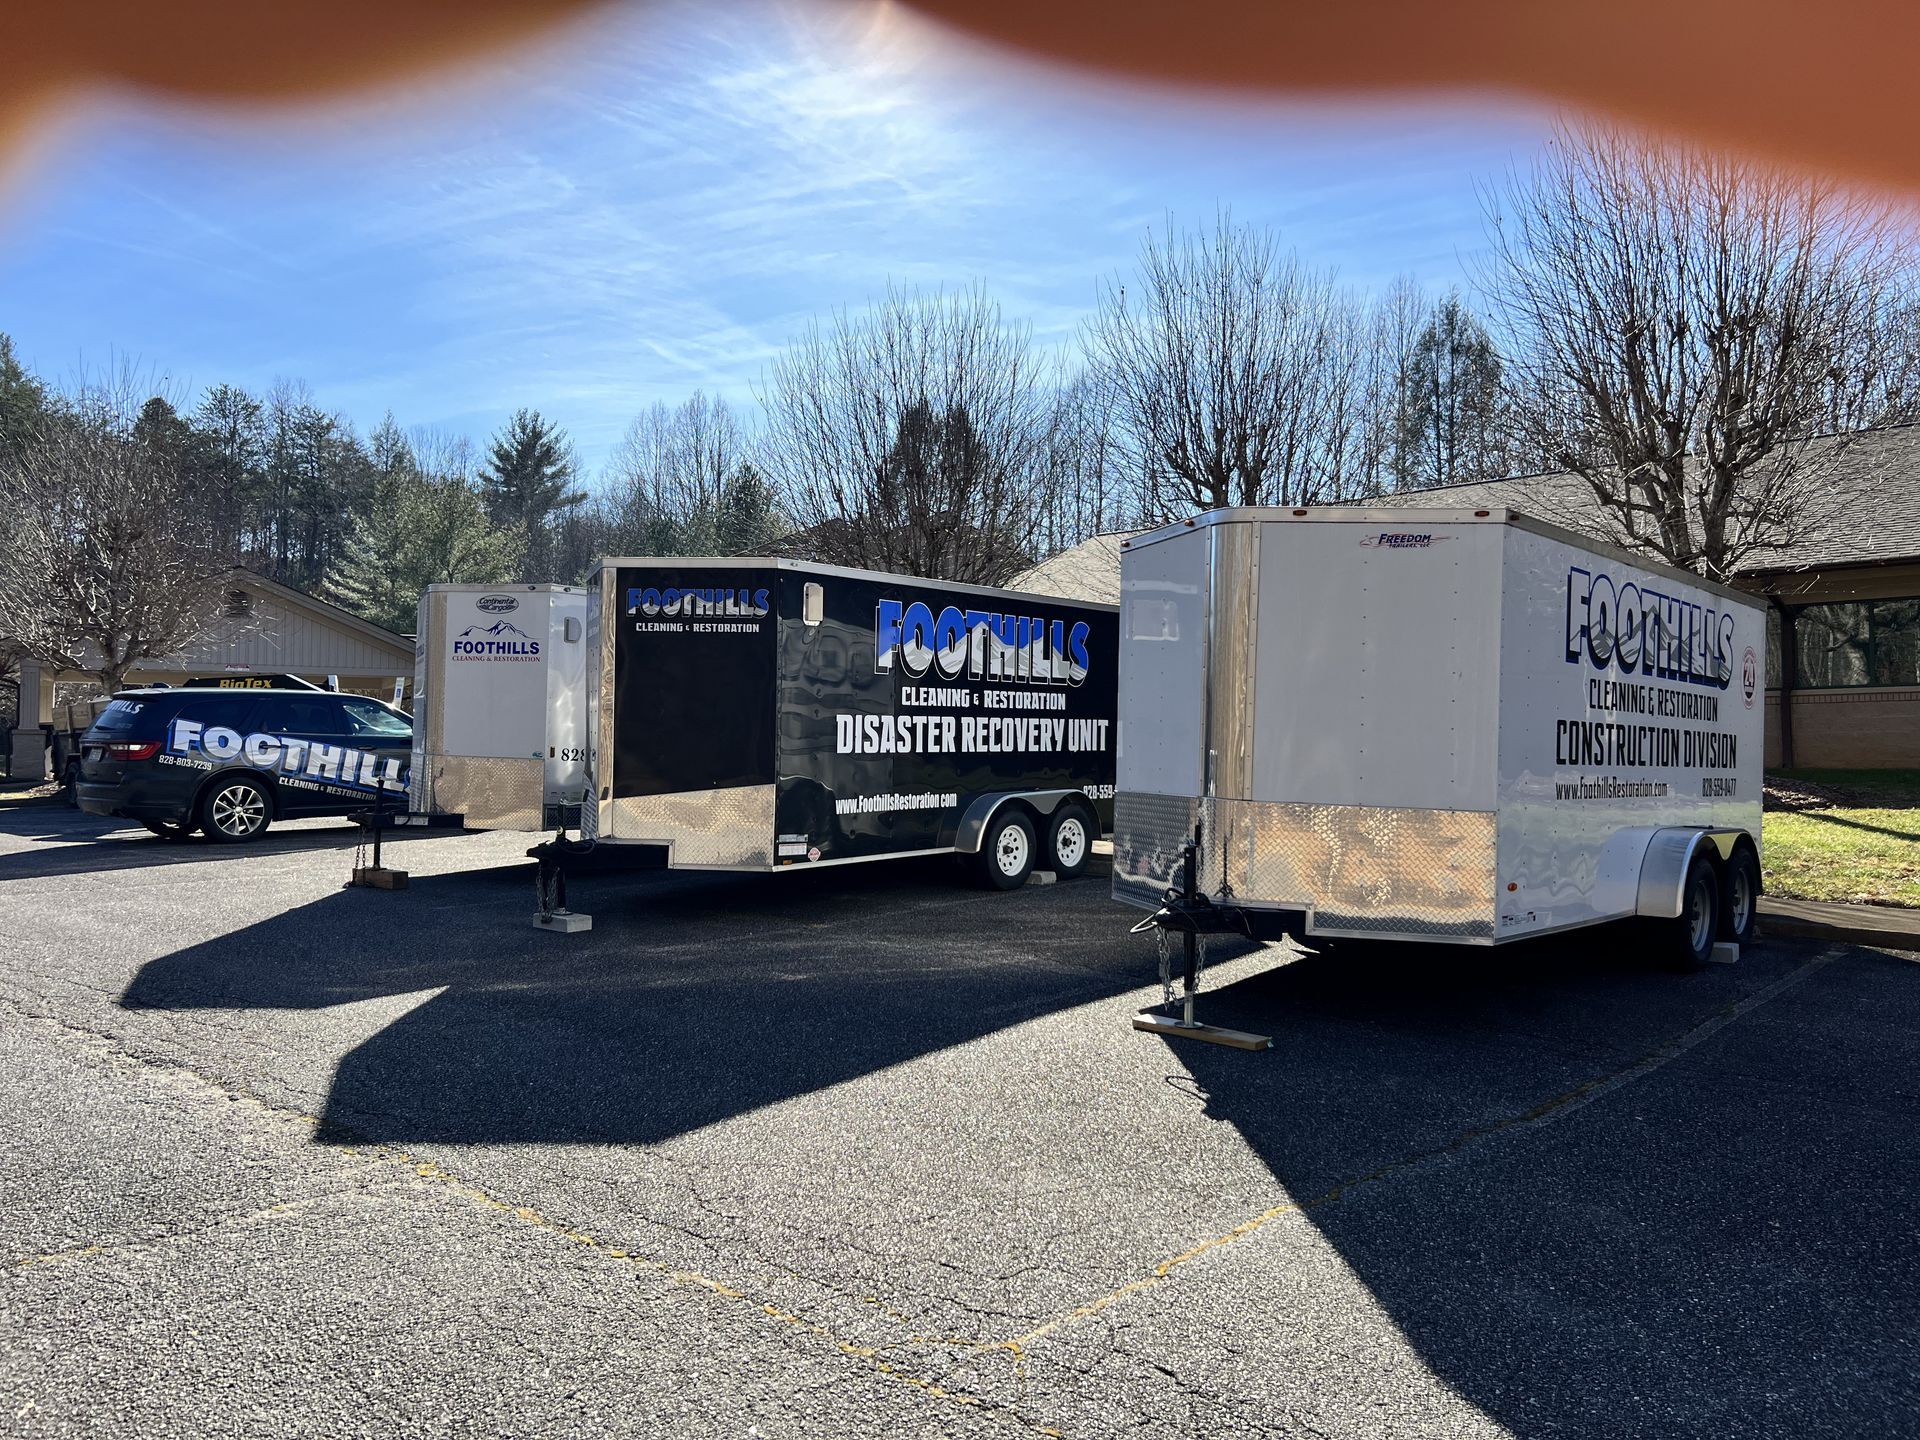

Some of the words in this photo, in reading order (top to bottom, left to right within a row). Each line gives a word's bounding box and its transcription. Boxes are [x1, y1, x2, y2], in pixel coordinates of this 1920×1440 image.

[1378, 533, 1431, 545] FREEDOM
[479, 597, 516, 605] Continental
[626, 588, 770, 619] FOOTHILLS
[636, 622, 683, 632] CLEANING
[693, 623, 760, 633] RESTORATION
[1566, 566, 1735, 690] FOOTHILLS
[454, 641, 540, 655] FOOTHILLS
[874, 598, 1091, 688] FOOTHILLS
[902, 686, 970, 708] CLEANING
[983, 690, 1067, 711] RESTORATION
[1589, 678, 1646, 714] CLEANING
[1657, 688, 1718, 722] RESTORATION
[836, 714, 956, 754] DISASTER
[961, 716, 1066, 753] RECOVERY
[1068, 719, 1109, 753] UNIT
[1556, 719, 1680, 768] CONSTRUCTION
[1683, 729, 1737, 769] DIVISION
[158, 754, 213, 771] 828-803-7239
[279, 776, 320, 791] CLEANING
[1555, 776, 1668, 800] www.FoothillsRestoration.com
